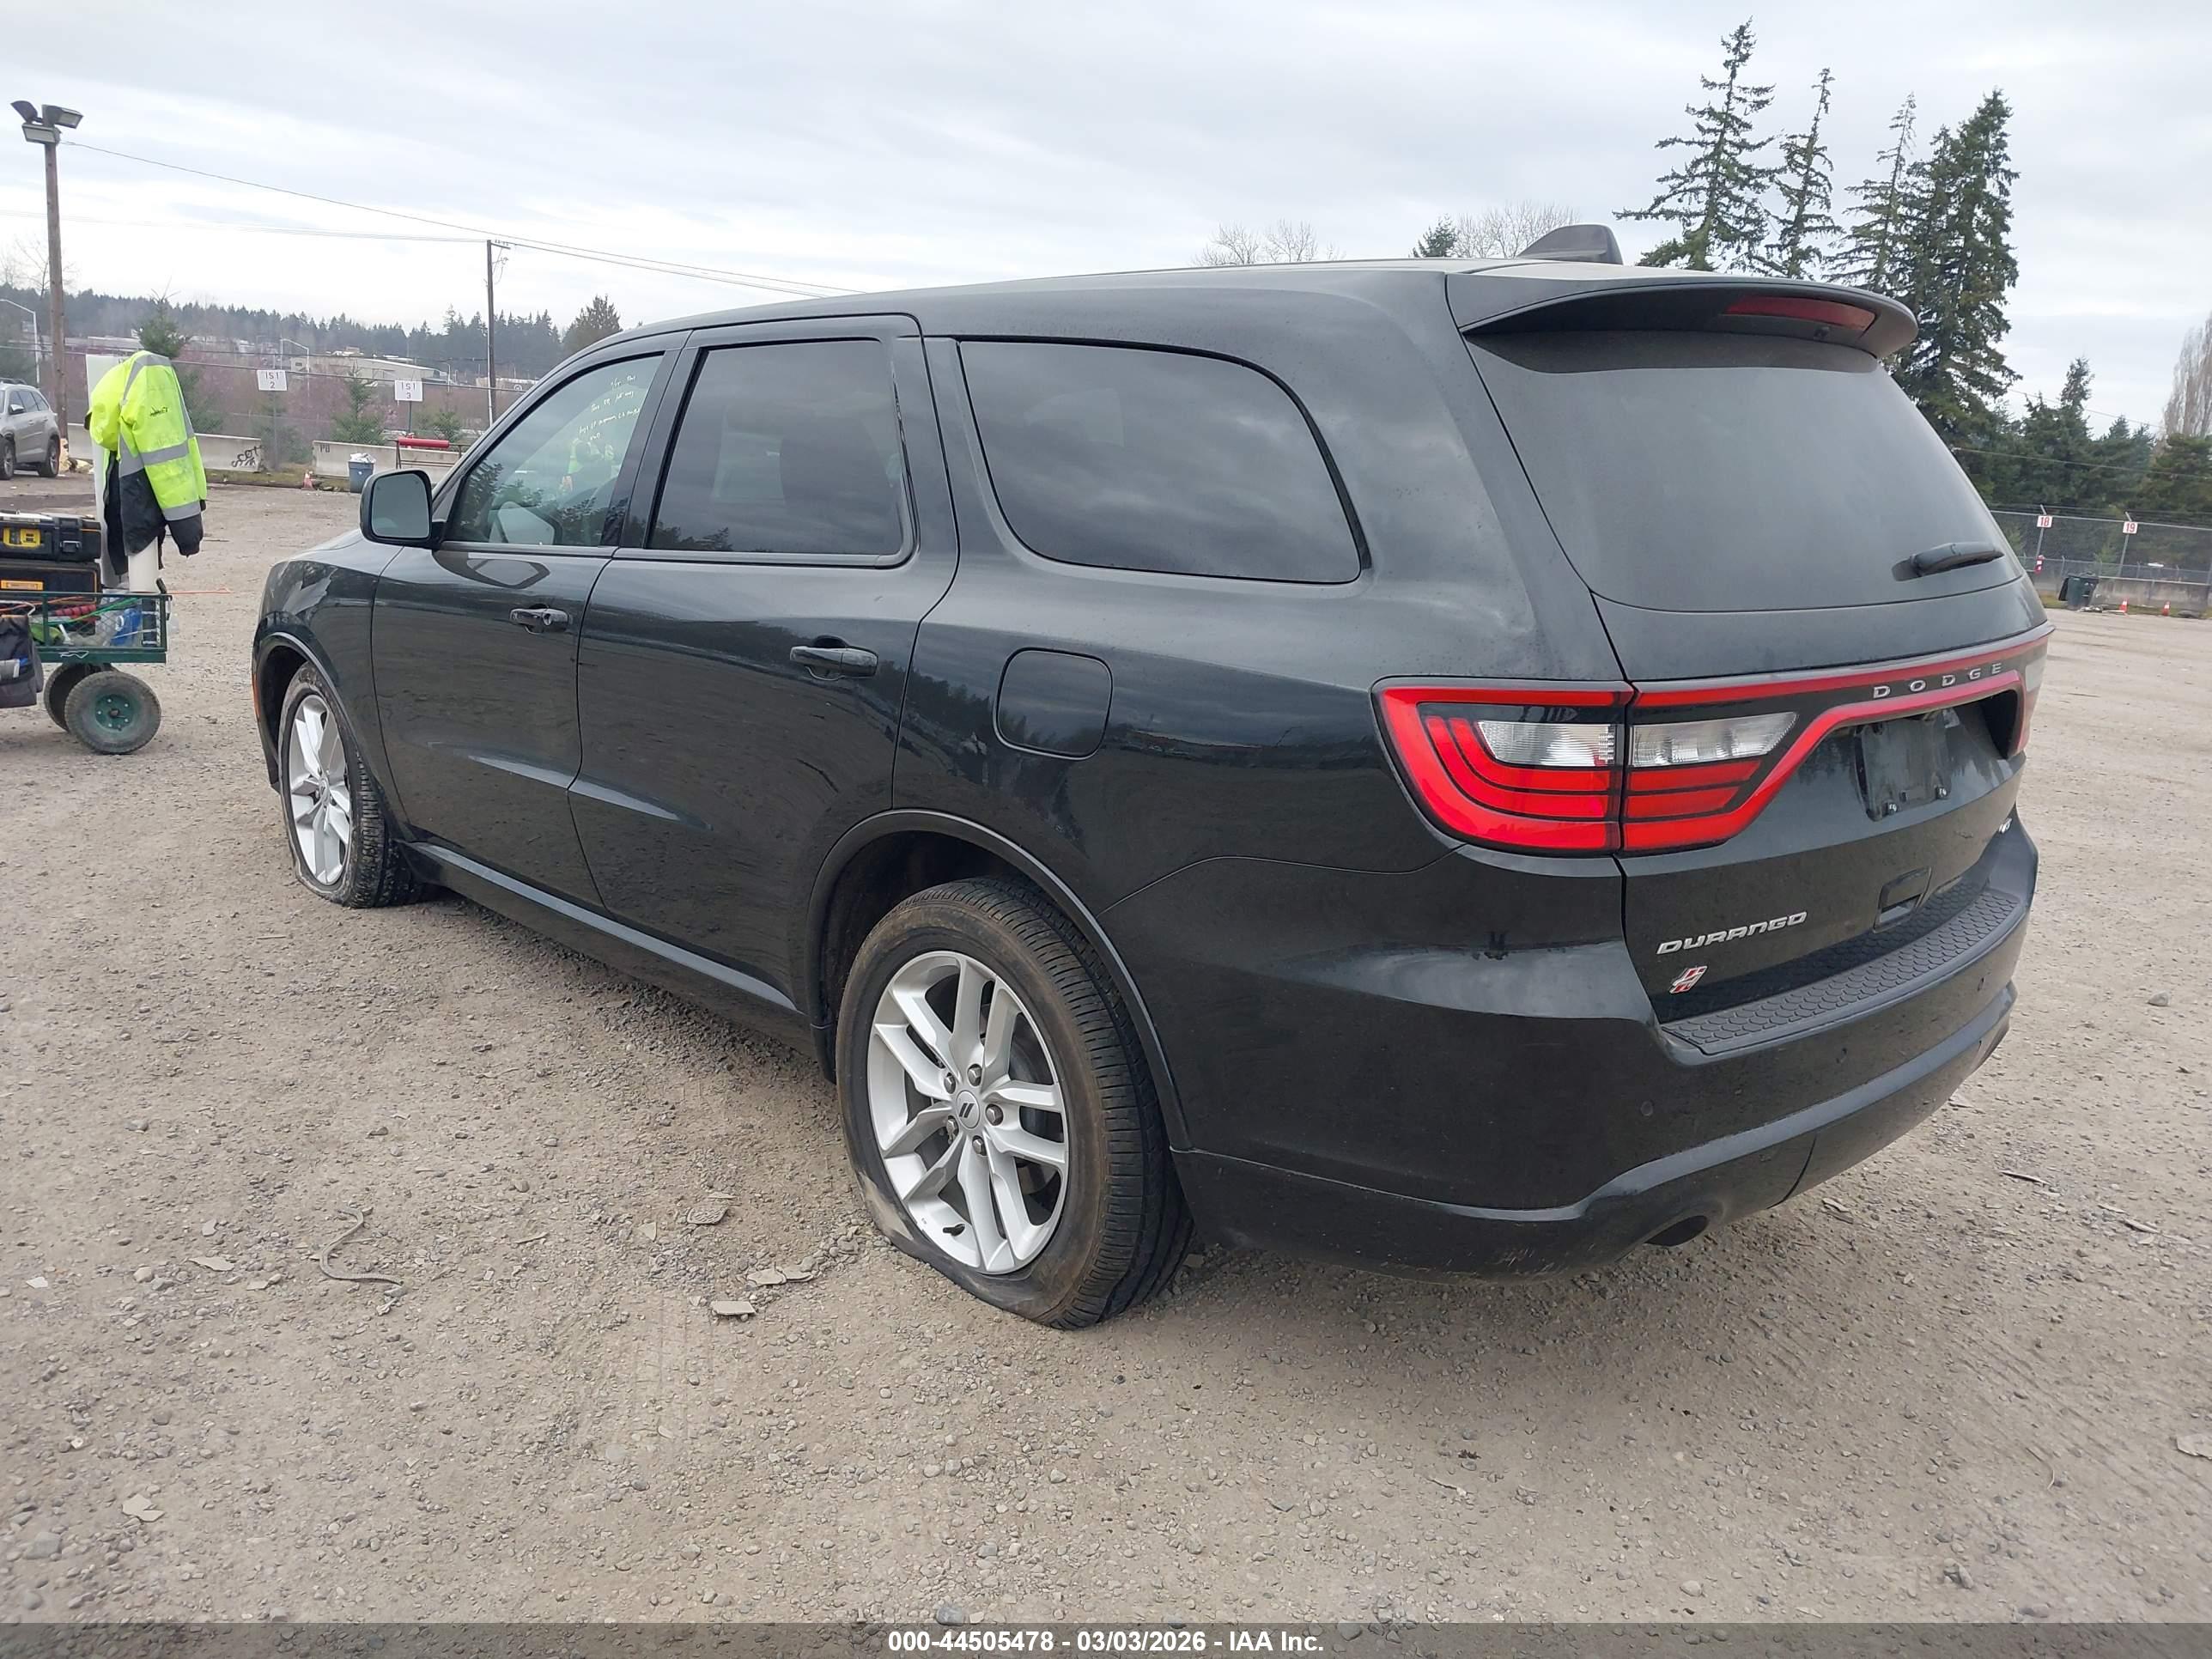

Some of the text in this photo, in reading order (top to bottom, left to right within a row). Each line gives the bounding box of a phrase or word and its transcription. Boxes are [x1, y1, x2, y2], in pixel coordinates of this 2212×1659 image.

[2040, 516, 2050, 526] 18
[2126, 522, 2136, 532] 19
[1873, 662, 2002, 699] DODGE
[1656, 911, 1808, 955] DURANGO
